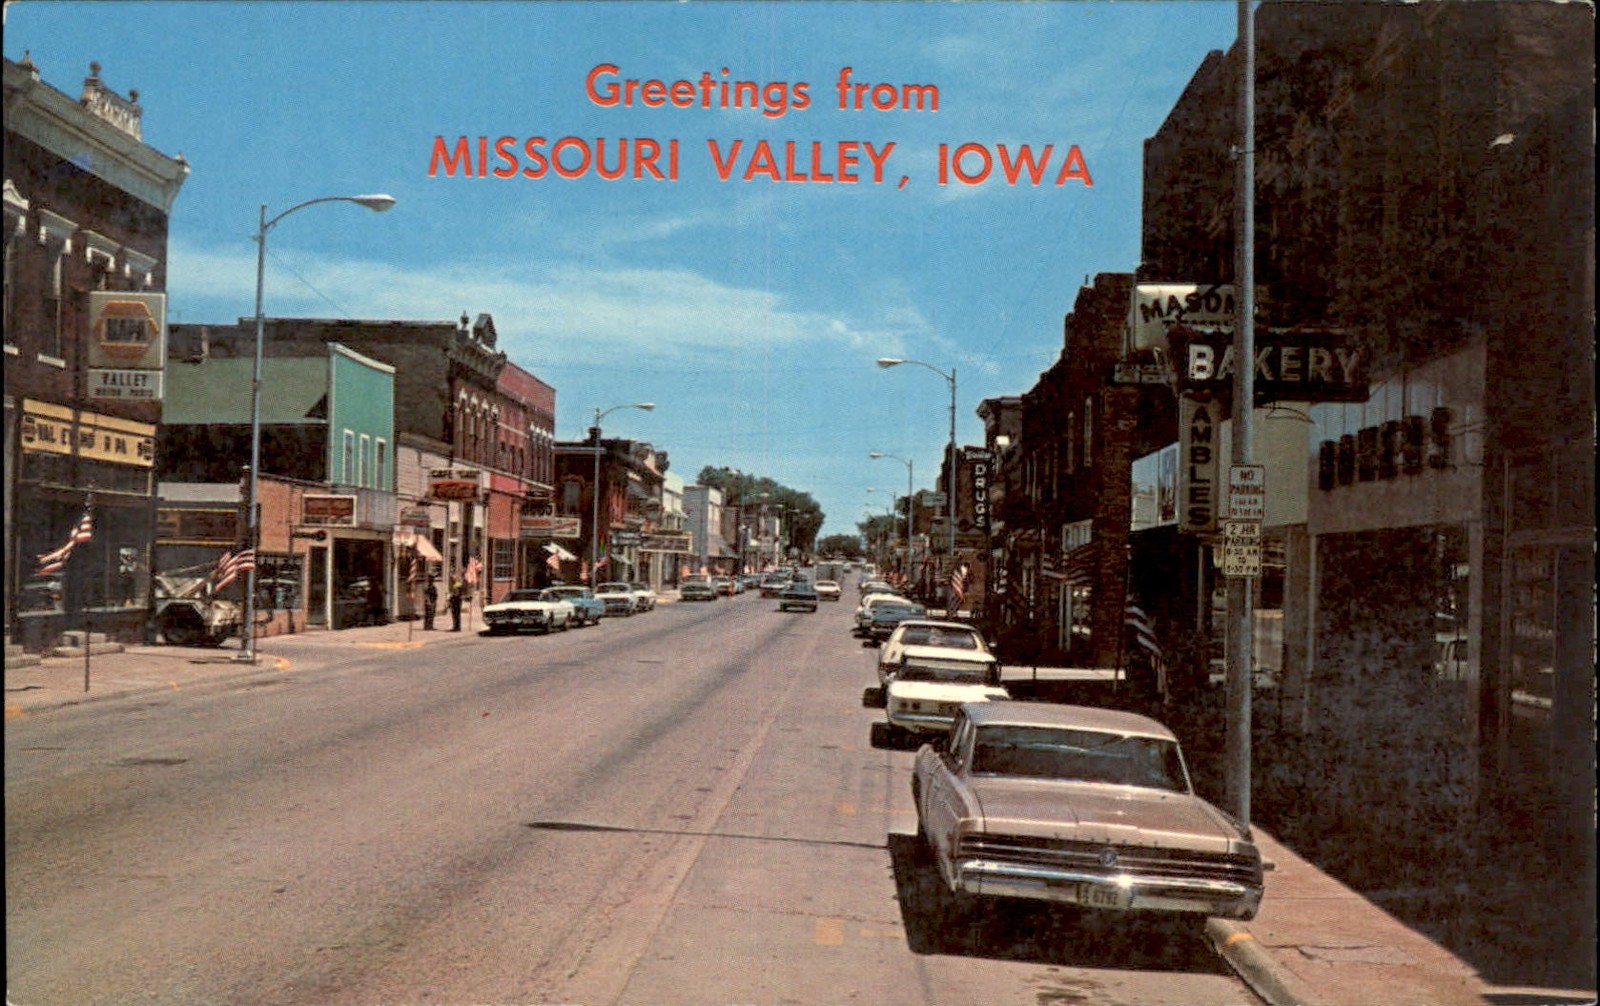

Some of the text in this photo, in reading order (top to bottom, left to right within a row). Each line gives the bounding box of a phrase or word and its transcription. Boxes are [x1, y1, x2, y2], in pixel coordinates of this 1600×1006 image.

[1188, 344, 1362, 382] BAKERY
[1188, 404, 1213, 526] AMBLES
[1240, 470, 1254, 480] NO
[974, 463, 987, 528] DRUGS
[1230, 524, 1256, 536] 2 HR
